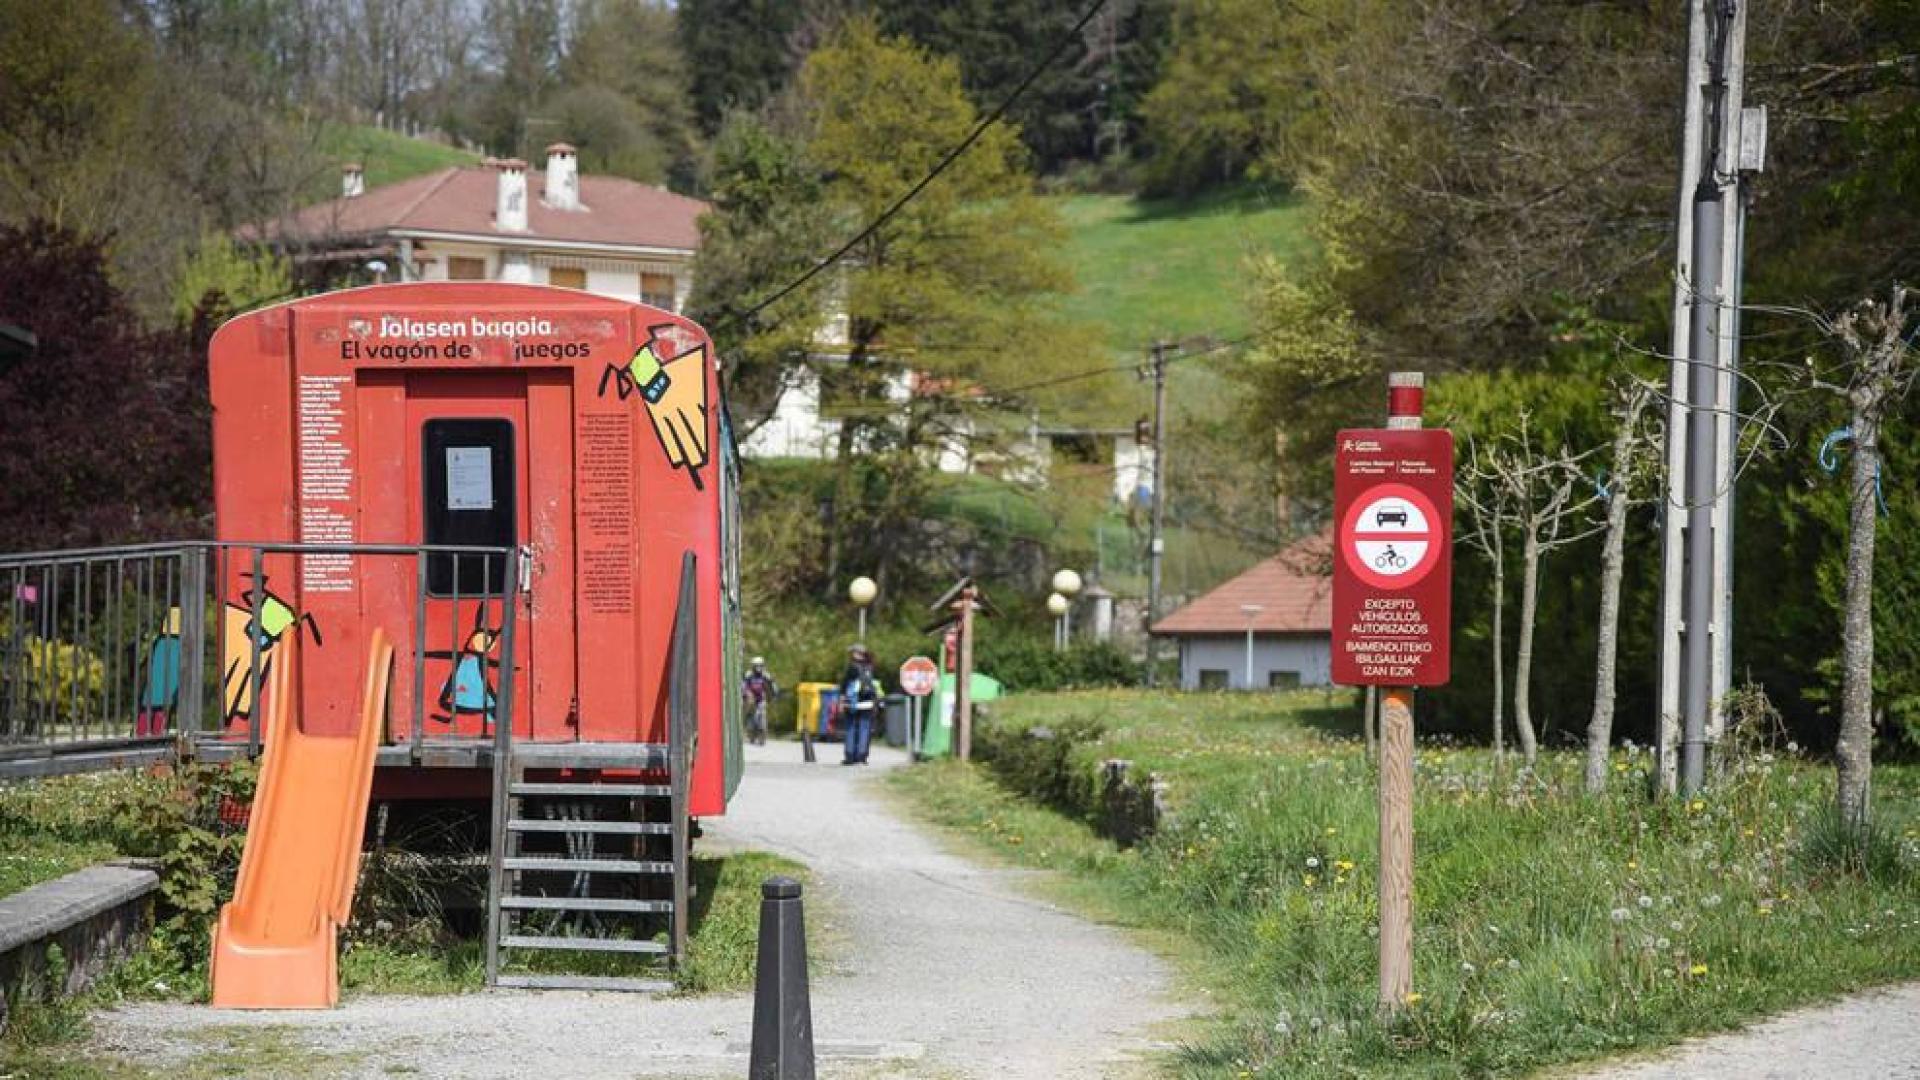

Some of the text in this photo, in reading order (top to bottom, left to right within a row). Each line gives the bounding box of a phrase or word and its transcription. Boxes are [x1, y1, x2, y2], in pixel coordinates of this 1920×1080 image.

[380, 317, 551, 340] Jolasen bagoia
[341, 341, 591, 363] El vagón de juegos
[1365, 599, 1415, 610] EXCEPTO
[1351, 623, 1428, 634] AUTORIZADOS
[1345, 641, 1432, 653] BAIMENDUTEKO
[1362, 666, 1415, 677] IZAN EZIK
